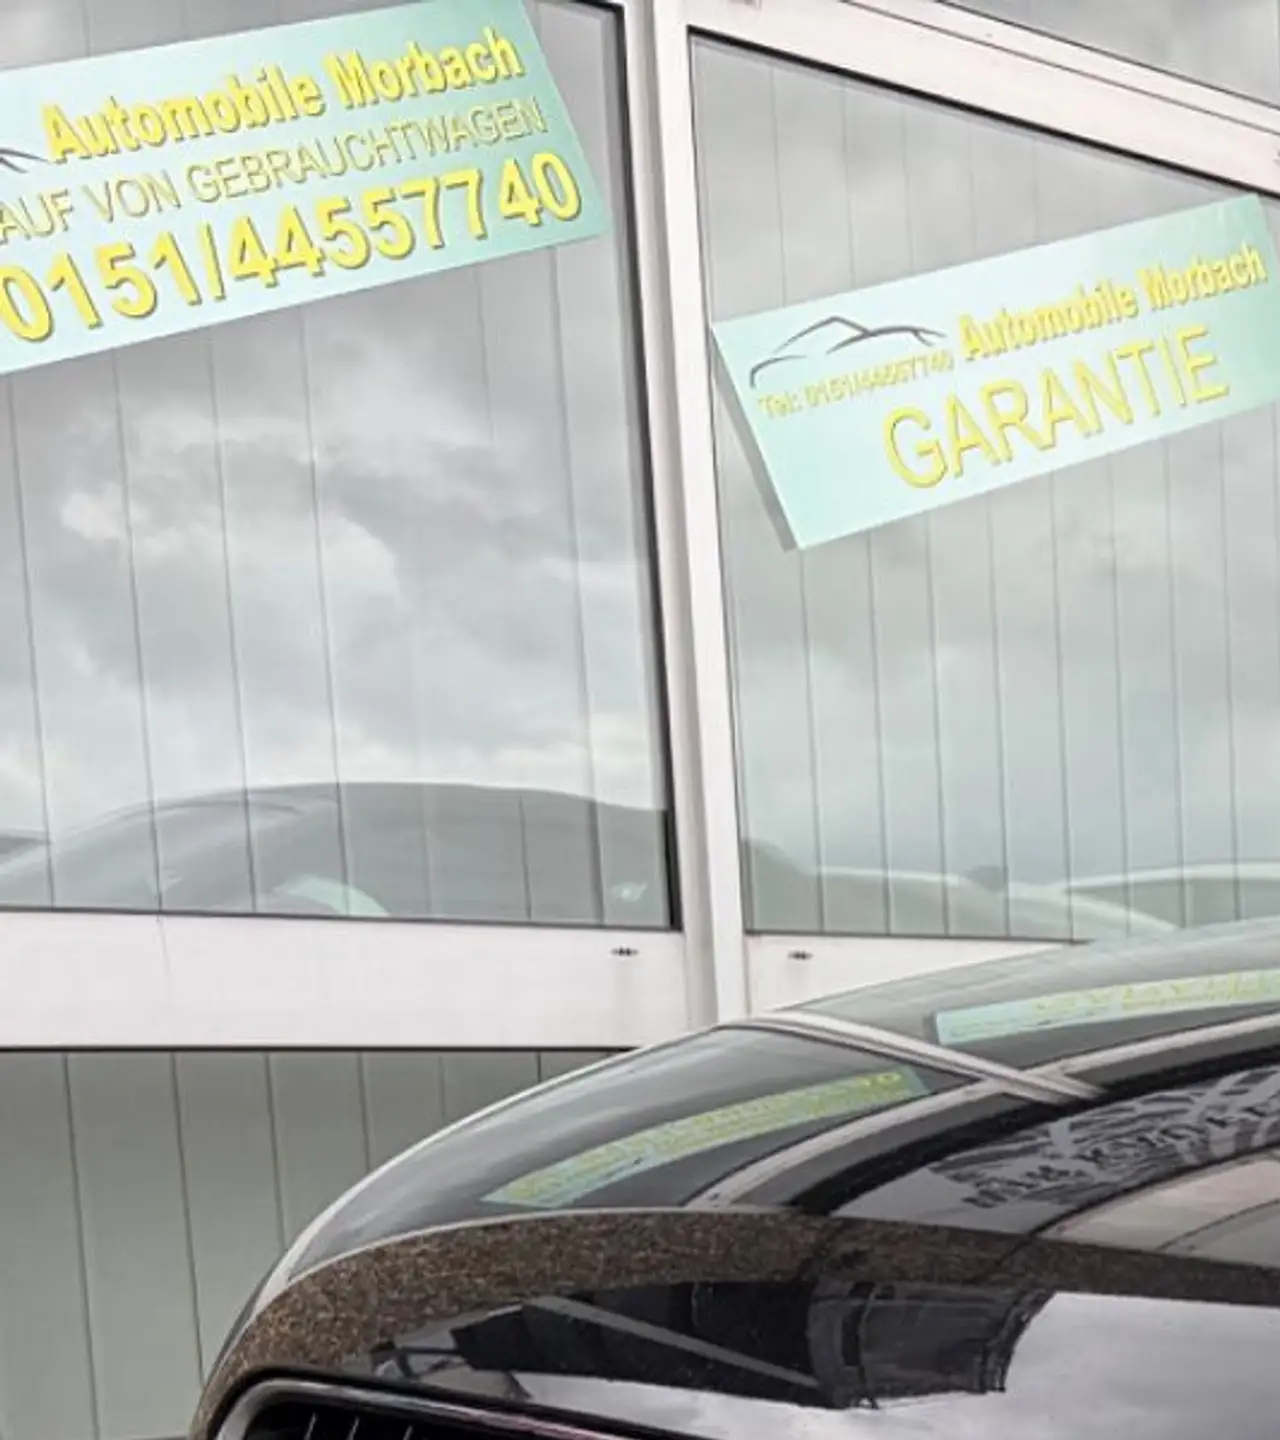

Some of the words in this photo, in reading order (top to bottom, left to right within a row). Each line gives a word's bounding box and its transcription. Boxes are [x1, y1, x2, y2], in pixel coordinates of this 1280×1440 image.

[42, 66, 327, 164] Automobile
[323, 26, 526, 110] Morbach
[82, 168, 181, 224] VON
[185, 96, 549, 204] GEBRAUCHTWAGEN
[958, 281, 1139, 361] Automobile
[1135, 242, 1268, 312] Morbach
[883, 324, 1230, 489] GARANTIE
